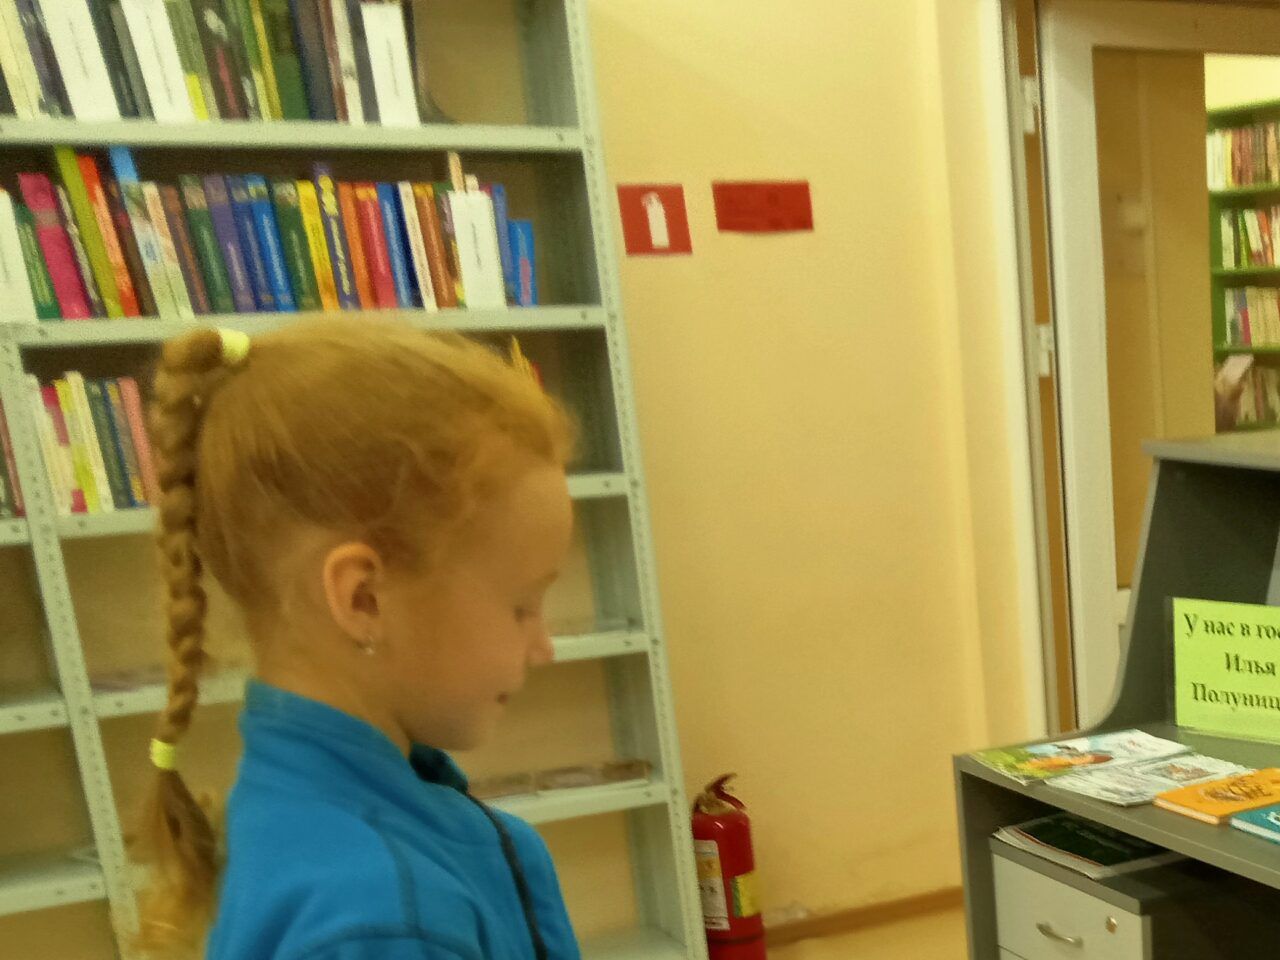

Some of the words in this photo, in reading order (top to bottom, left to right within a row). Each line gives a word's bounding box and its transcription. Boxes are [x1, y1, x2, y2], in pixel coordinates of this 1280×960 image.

[1184, 612, 1198, 638] У
[1203, 619, 1235, 637] нас
[1240, 621, 1251, 637] в
[1225, 652, 1276, 676] Илья
